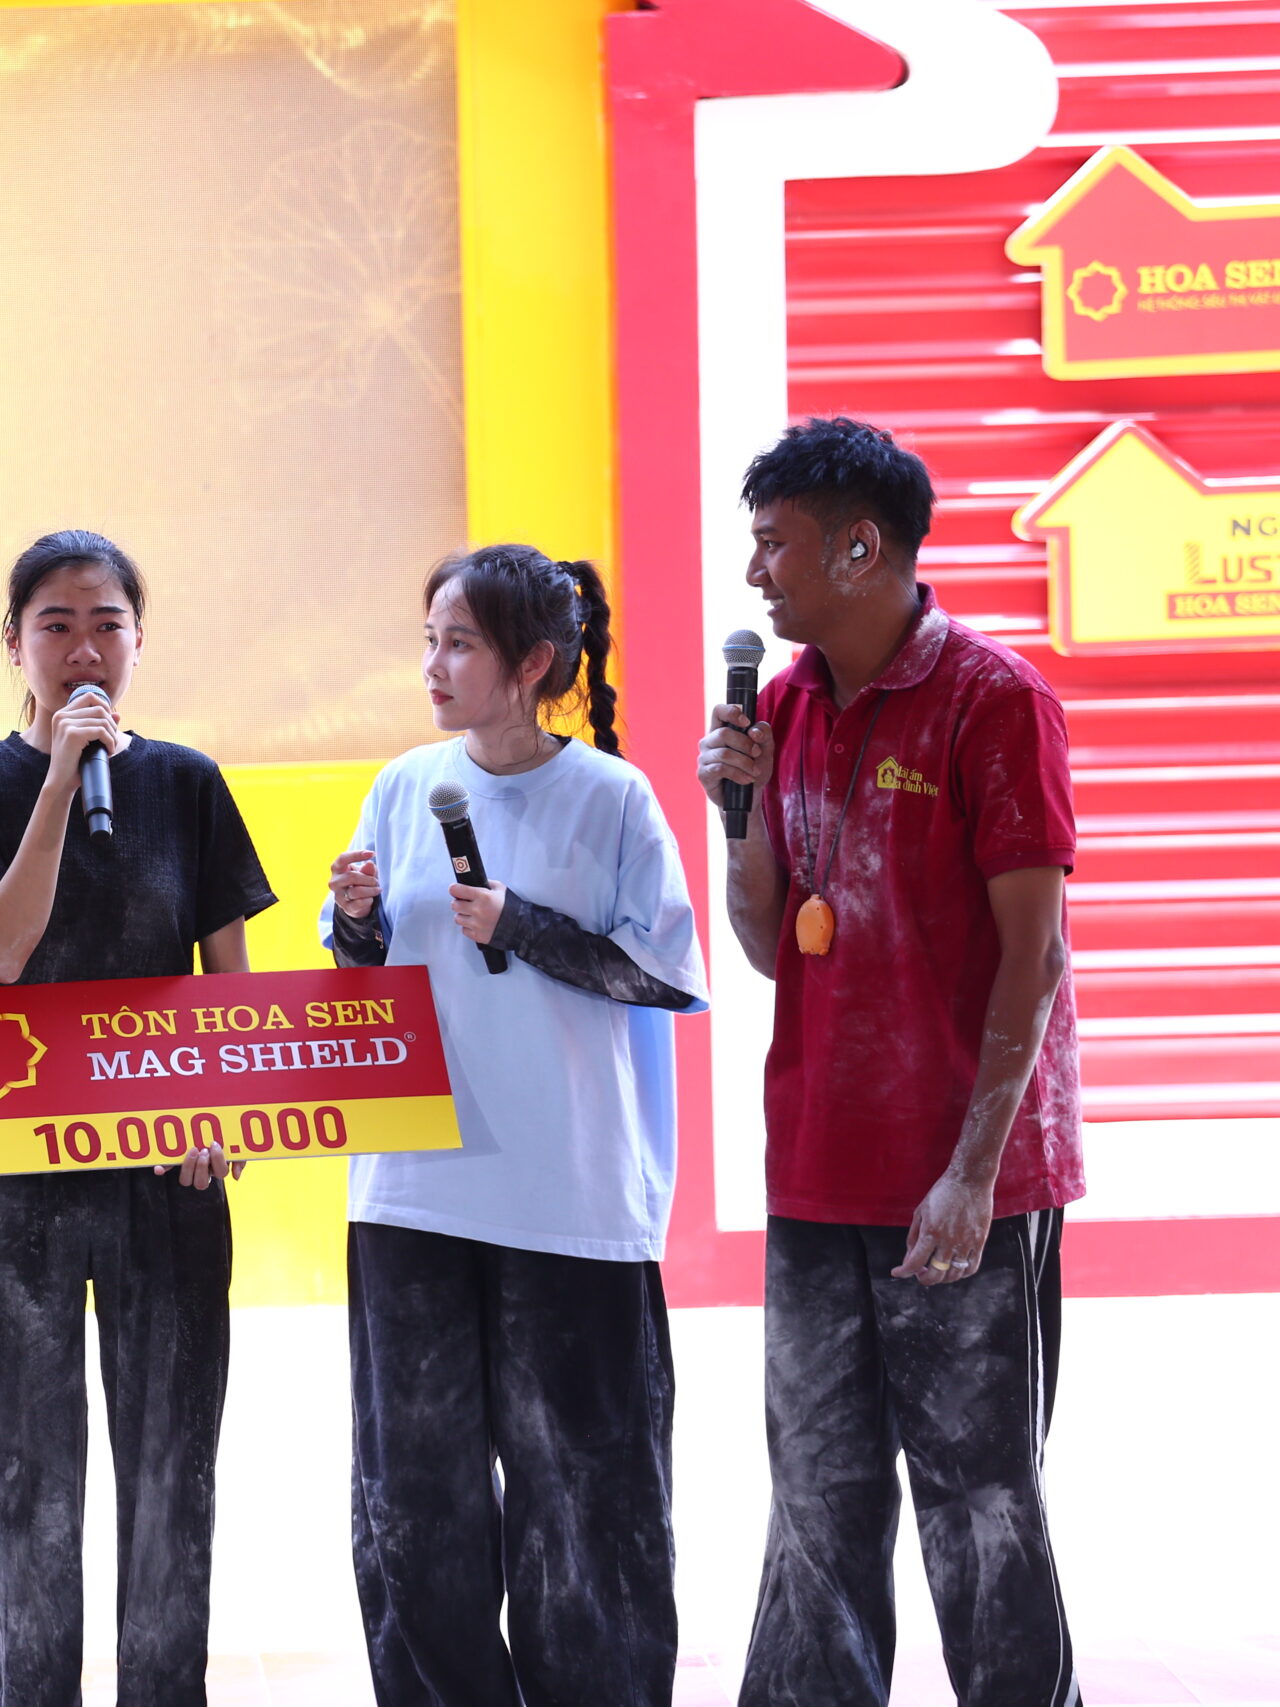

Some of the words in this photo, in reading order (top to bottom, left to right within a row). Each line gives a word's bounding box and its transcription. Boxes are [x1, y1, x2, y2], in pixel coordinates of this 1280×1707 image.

[1137, 263, 1220, 294] HOA
[1185, 543, 1280, 584] LUS
[1175, 594, 1231, 617] HOA
[81, 1006, 177, 1039] TÔN
[194, 1004, 294, 1034] HOA
[306, 999, 395, 1027] SEN
[86, 1046, 206, 1081] MAG
[33, 1106, 348, 1165] 10.000.000
